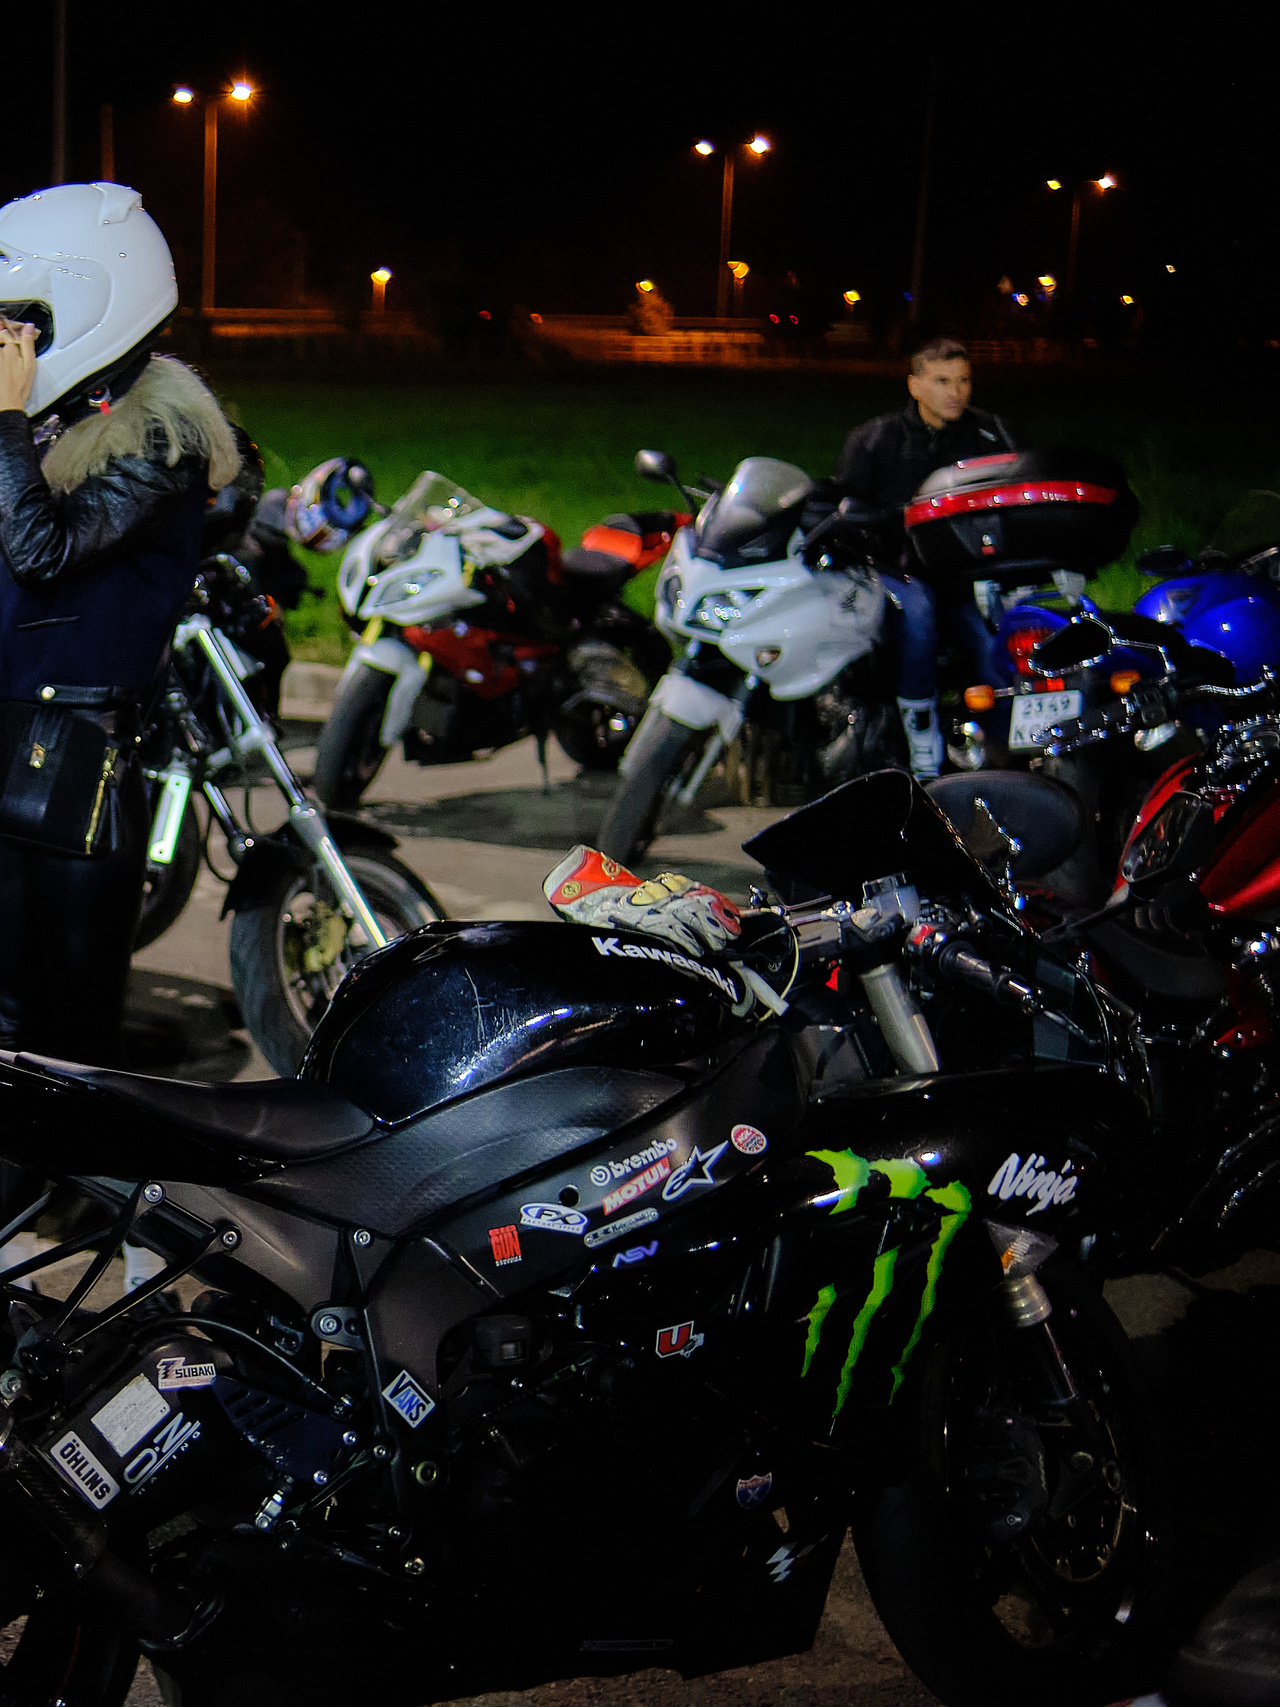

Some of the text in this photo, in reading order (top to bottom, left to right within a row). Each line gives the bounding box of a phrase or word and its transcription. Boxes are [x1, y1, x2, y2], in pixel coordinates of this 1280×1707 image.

[591, 937, 738, 1002] Kawasaki
[609, 1138, 677, 1178] brembo
[987, 1153, 1078, 1216] Ninja
[603, 1161, 669, 1214] MOTUL
[612, 1240, 659, 1269] ASV
[388, 1373, 431, 1421] VANS
[59, 1438, 111, 1500] ÖHLINS
